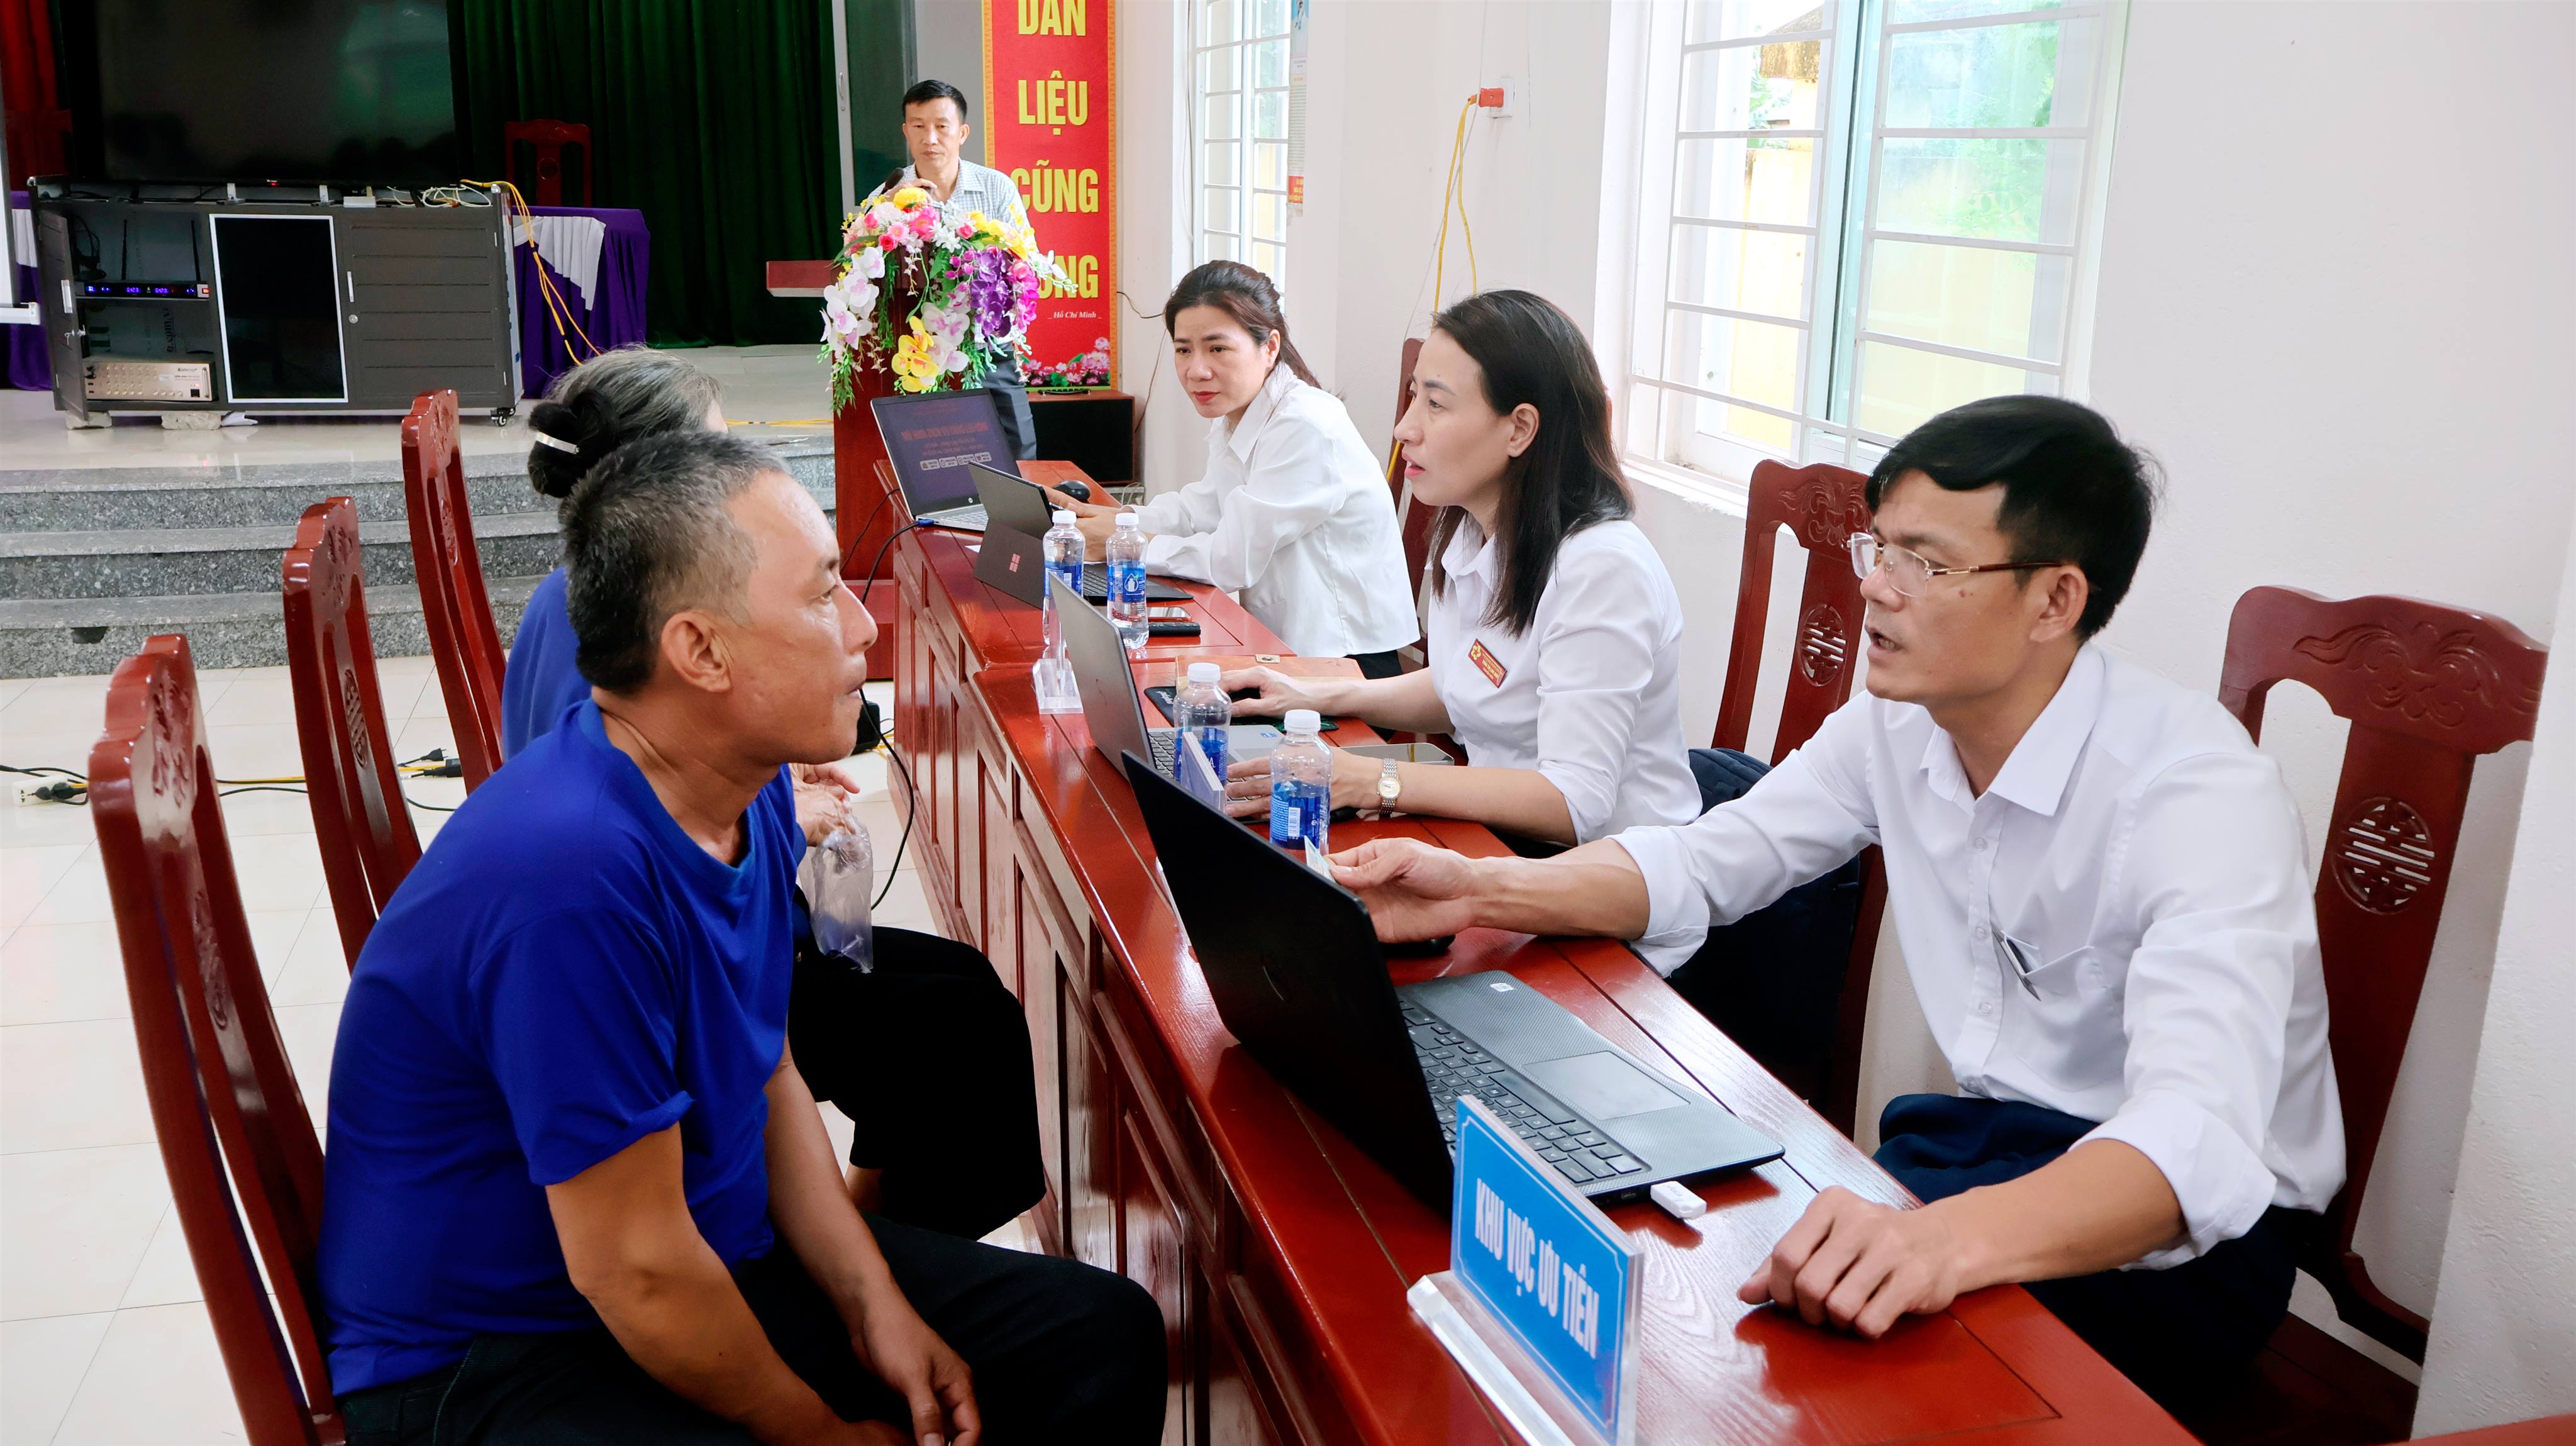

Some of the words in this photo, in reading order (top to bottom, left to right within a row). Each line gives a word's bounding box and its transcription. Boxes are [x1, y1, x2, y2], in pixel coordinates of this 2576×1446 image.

[1018, 70, 1089, 136] LIỆU
[1010, 159, 1099, 213] CŨNG
[1474, 1177, 1505, 1260] KHU
[1507, 1206, 1536, 1297] VỰC
[1538, 1238, 1560, 1318] ƯU
[1562, 1262, 1600, 1360] TIÊN
